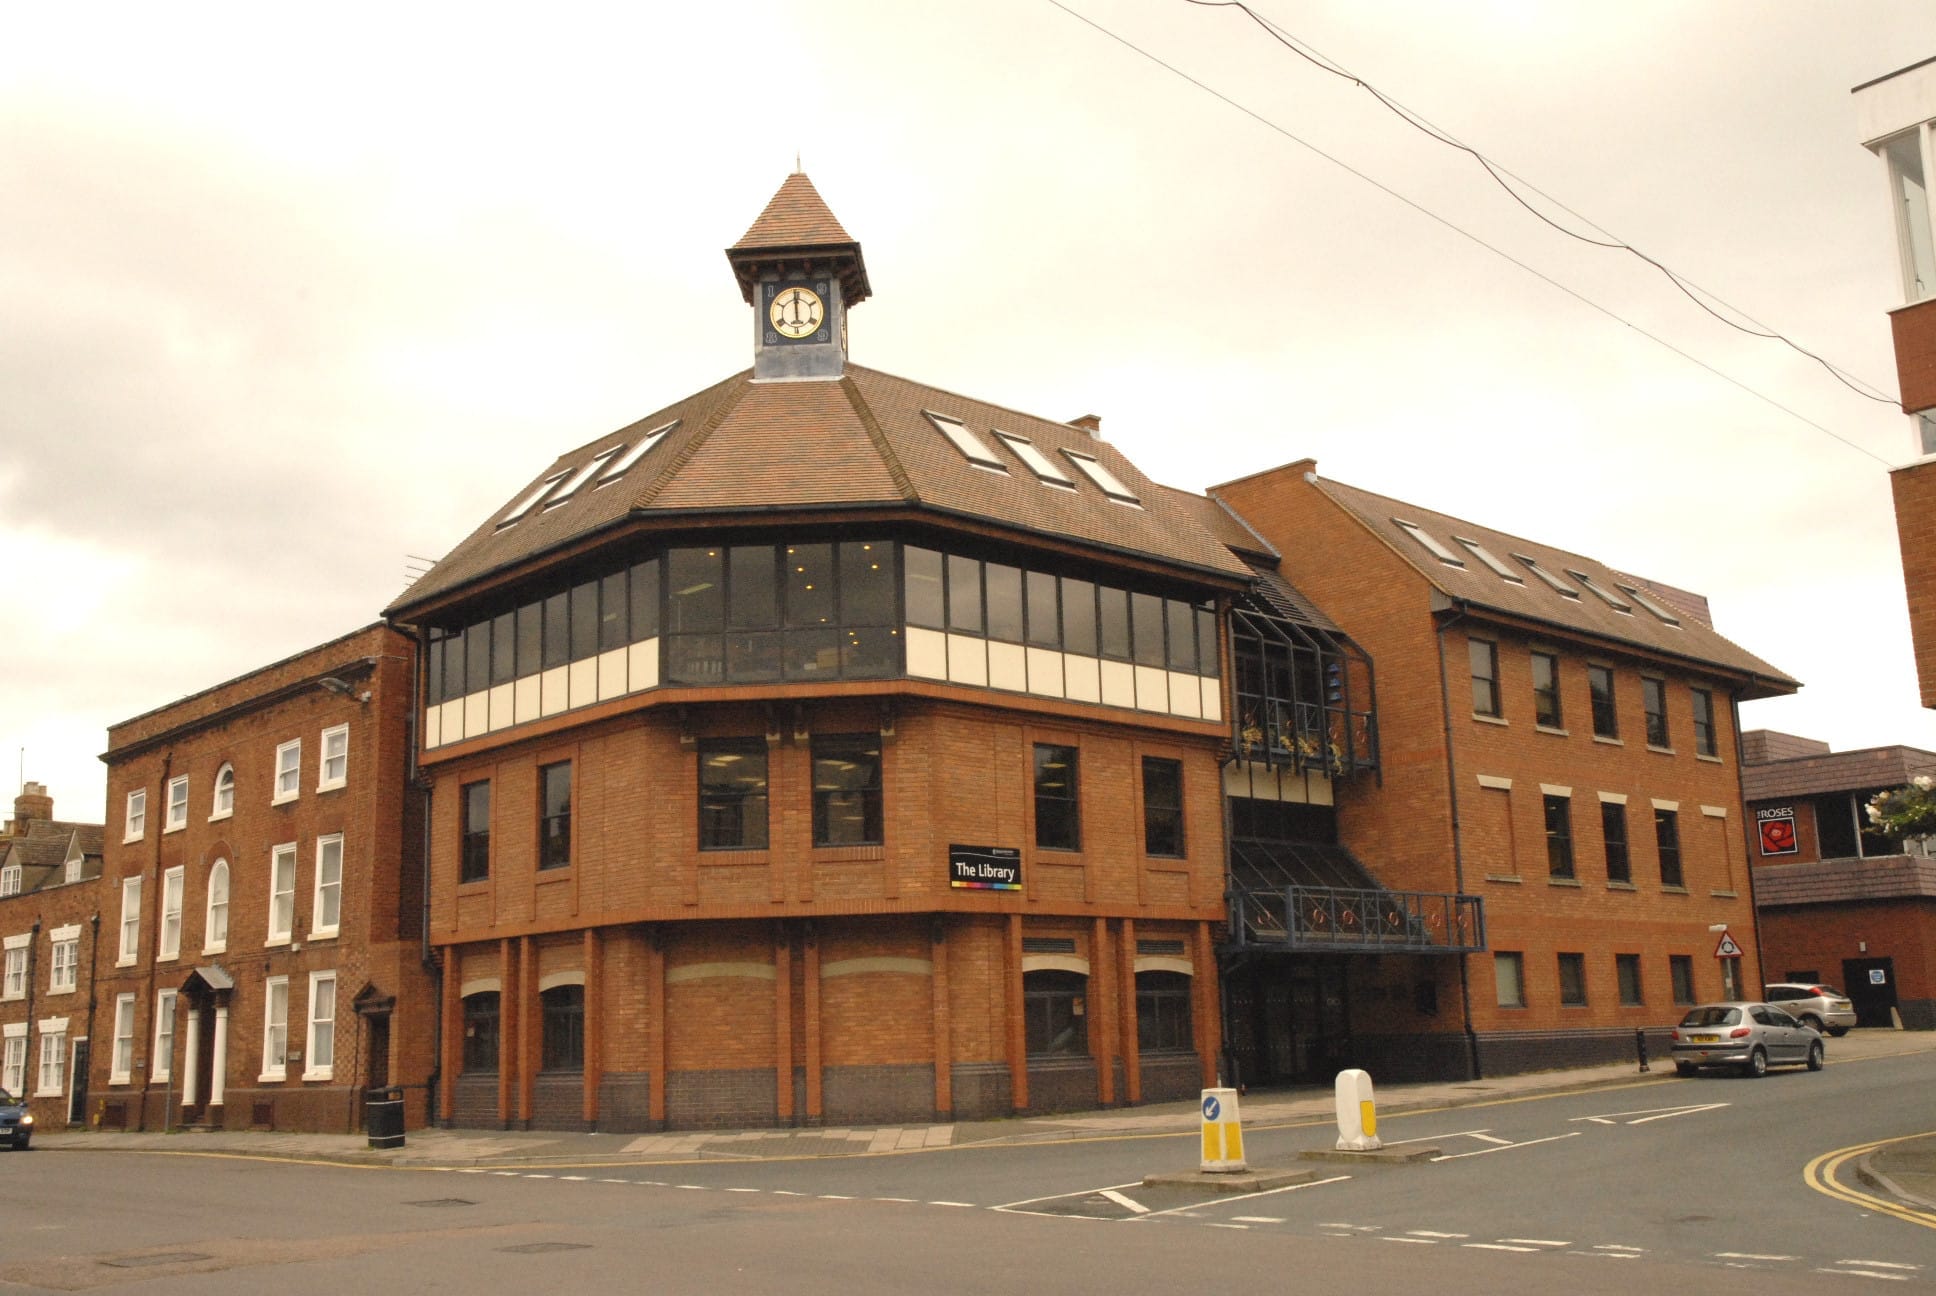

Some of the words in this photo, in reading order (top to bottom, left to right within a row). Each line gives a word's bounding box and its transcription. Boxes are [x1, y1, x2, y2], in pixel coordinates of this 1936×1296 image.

[1760, 806, 1794, 819] ROSES
[955, 862, 976, 876] The
[978, 863, 1015, 883] Library
